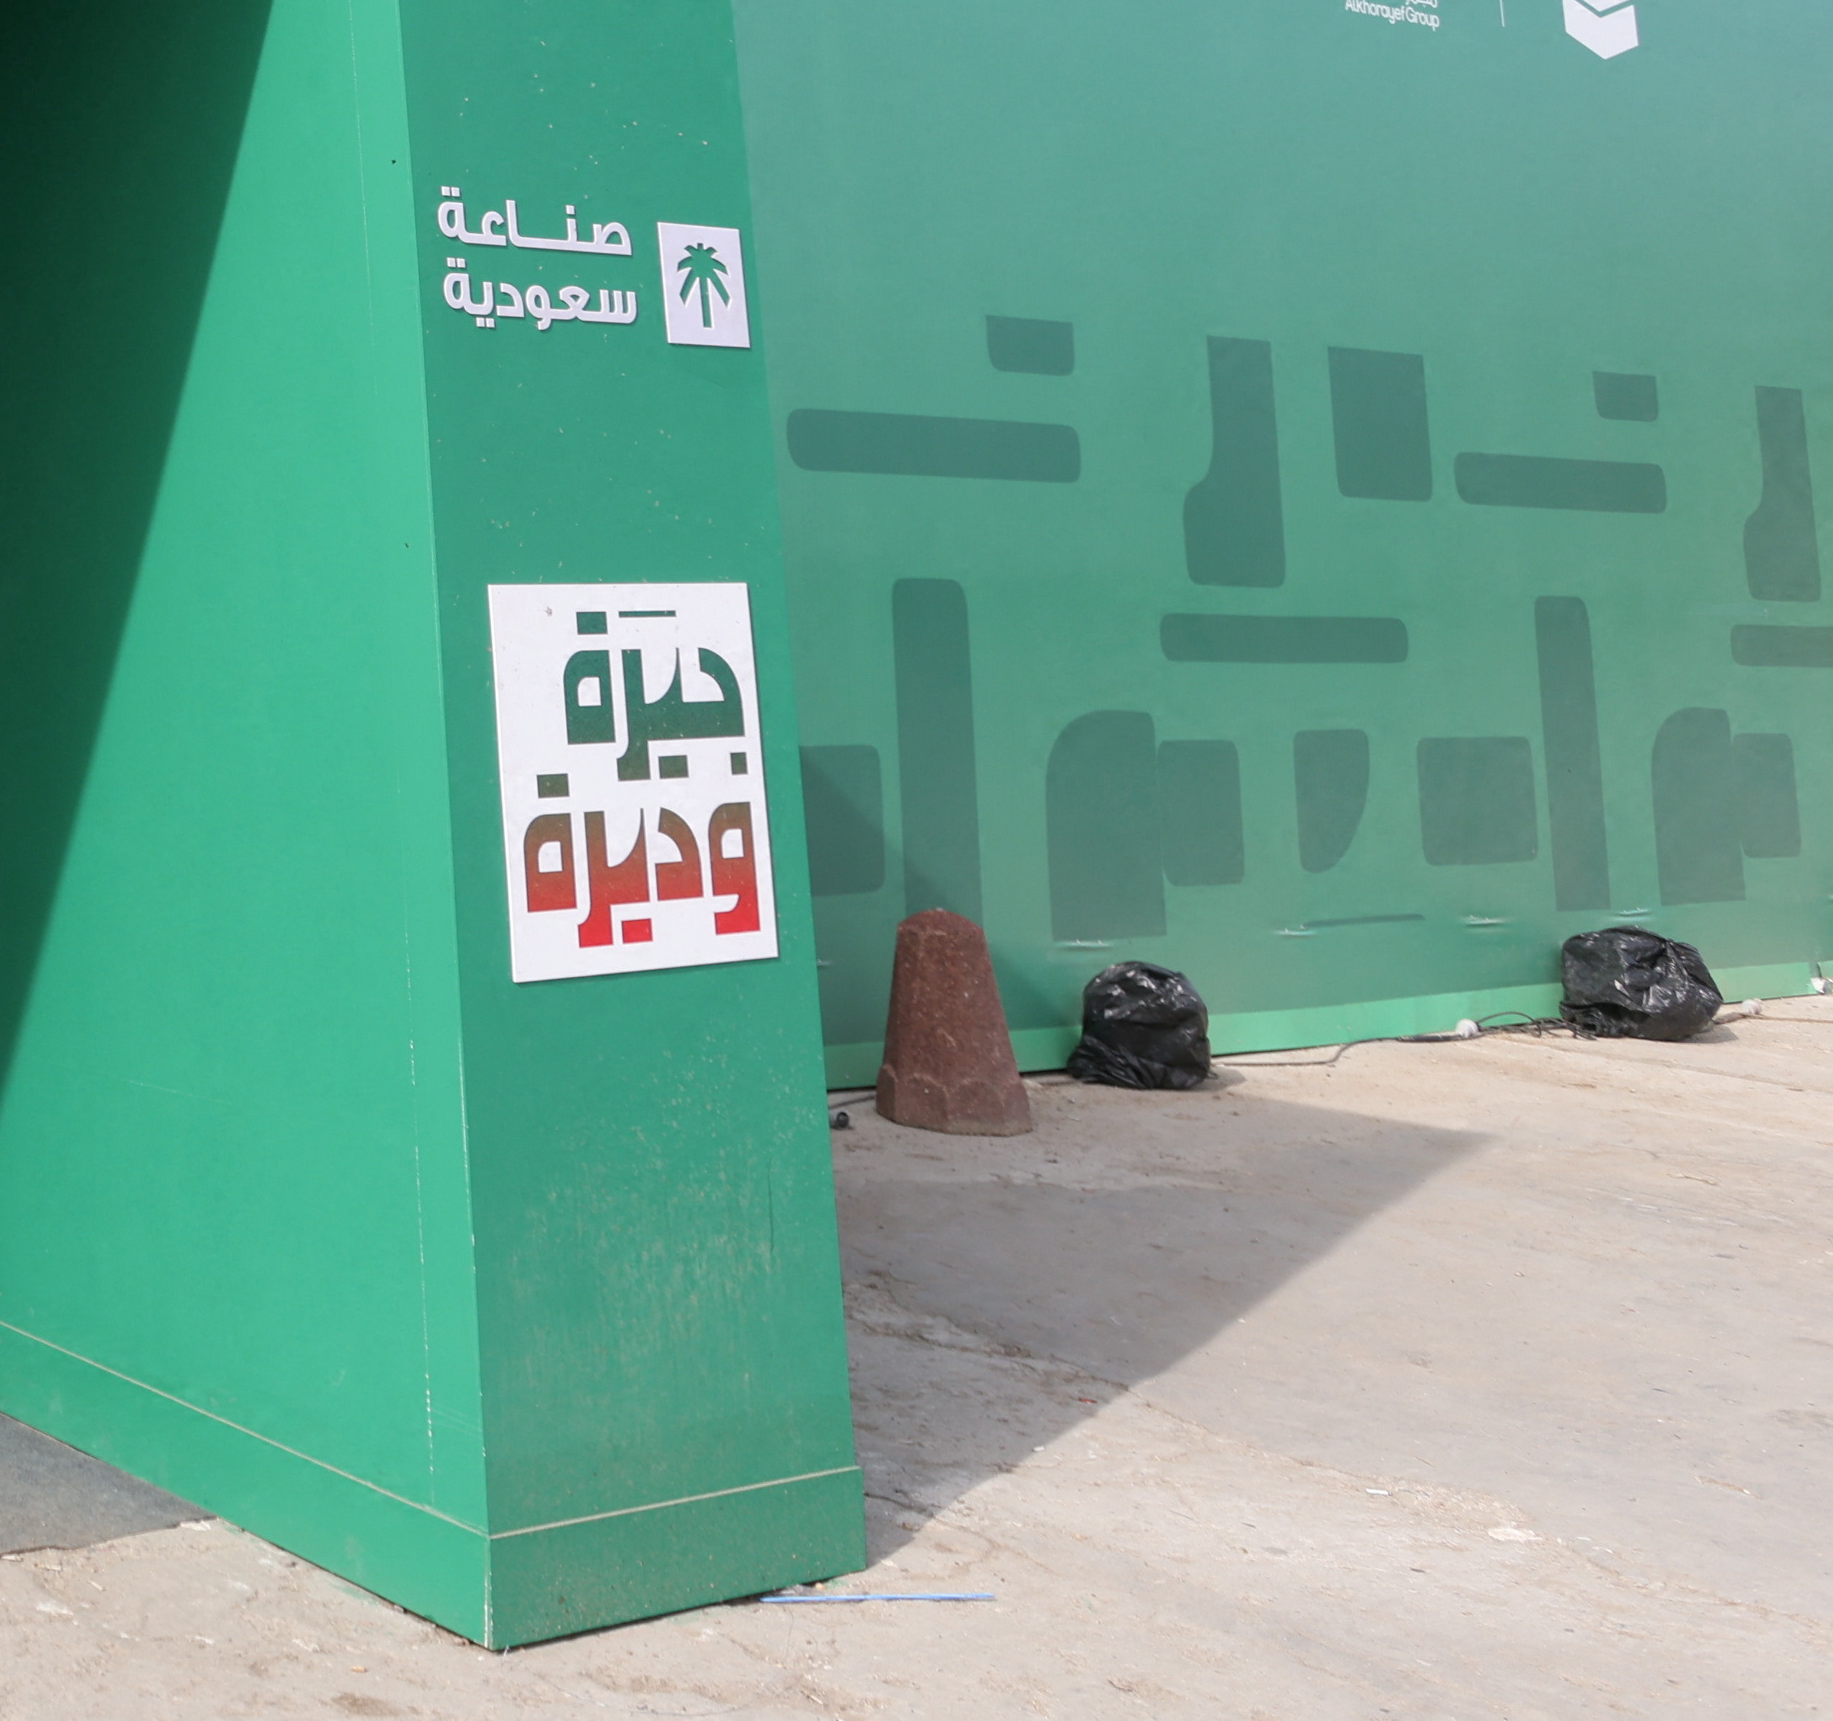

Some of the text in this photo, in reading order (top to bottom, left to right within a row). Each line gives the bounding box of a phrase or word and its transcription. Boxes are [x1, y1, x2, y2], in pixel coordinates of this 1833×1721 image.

[1406, 6, 1440, 32] Group
[437, 185, 633, 256] صناعة
[443, 257, 637, 331] سعودية
[523, 773, 761, 948] وديرة
